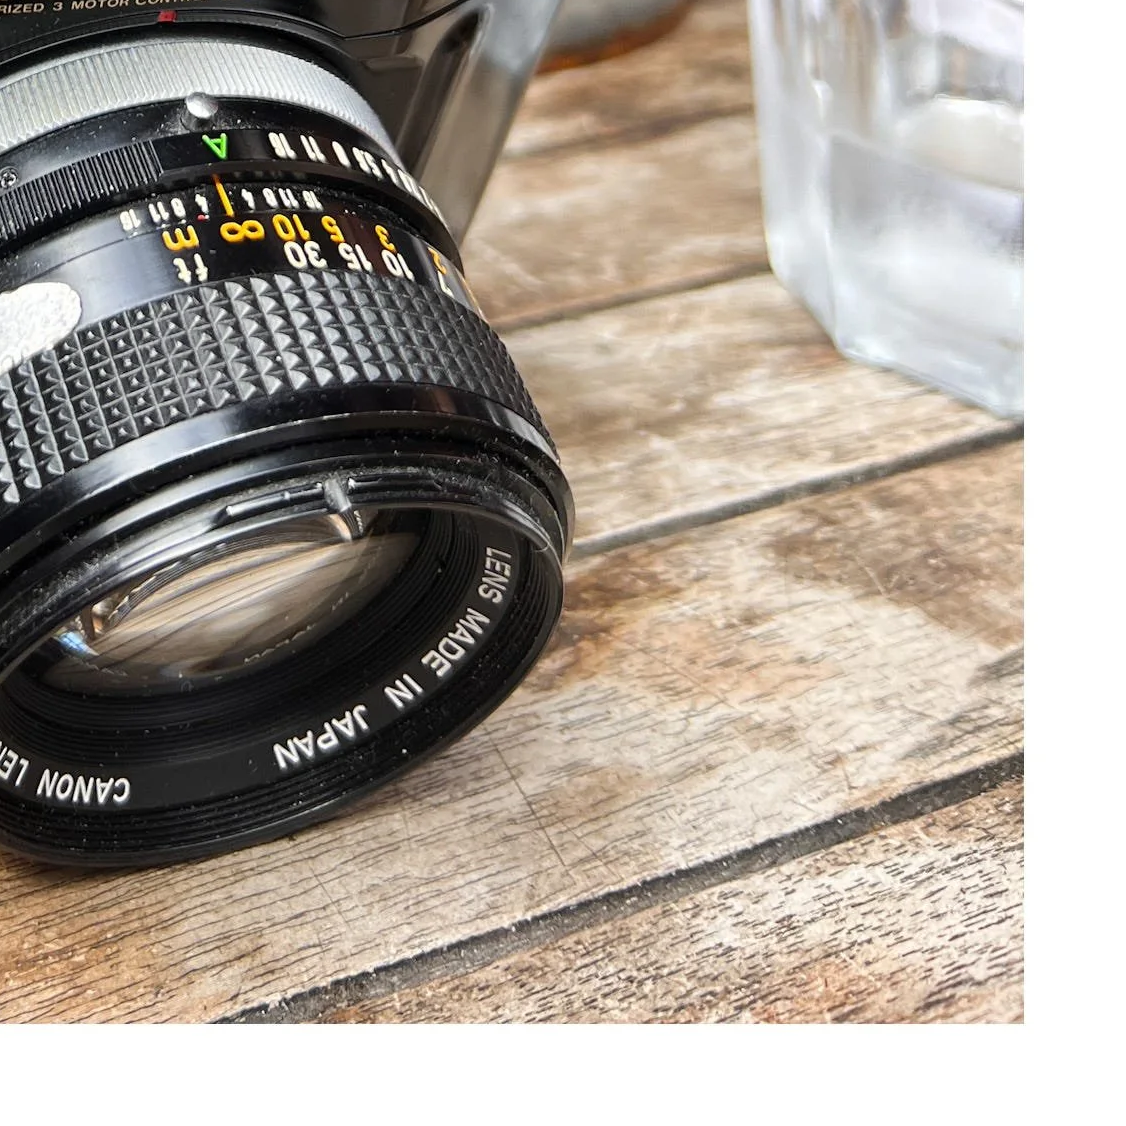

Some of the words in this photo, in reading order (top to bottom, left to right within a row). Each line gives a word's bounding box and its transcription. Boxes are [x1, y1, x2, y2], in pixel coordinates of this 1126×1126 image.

[52, 1, 64, 12] 3
[202, 132, 228, 161] A
[268, 132, 297, 161] 16
[300, 134, 327, 163] 11
[148, 200, 170, 224] 11
[194, 193, 210, 214] 4
[241, 188, 256, 211] 4
[278, 187, 300, 209] 11
[162, 224, 200, 251] m
[271, 213, 311, 242] 10
[321, 215, 345, 244] 5
[375, 225, 397, 253] 3
[173, 253, 209, 285] ft
[283, 240, 328, 270] 30
[338, 243, 373, 273] 15
[381, 249, 415, 282] 10
[478, 546, 512, 604] LENS
[420, 607, 491, 678] MADE
[383, 673, 424, 709] IN
[272, 704, 370, 770] JAPAN
[36, 768, 132, 805] CANON
